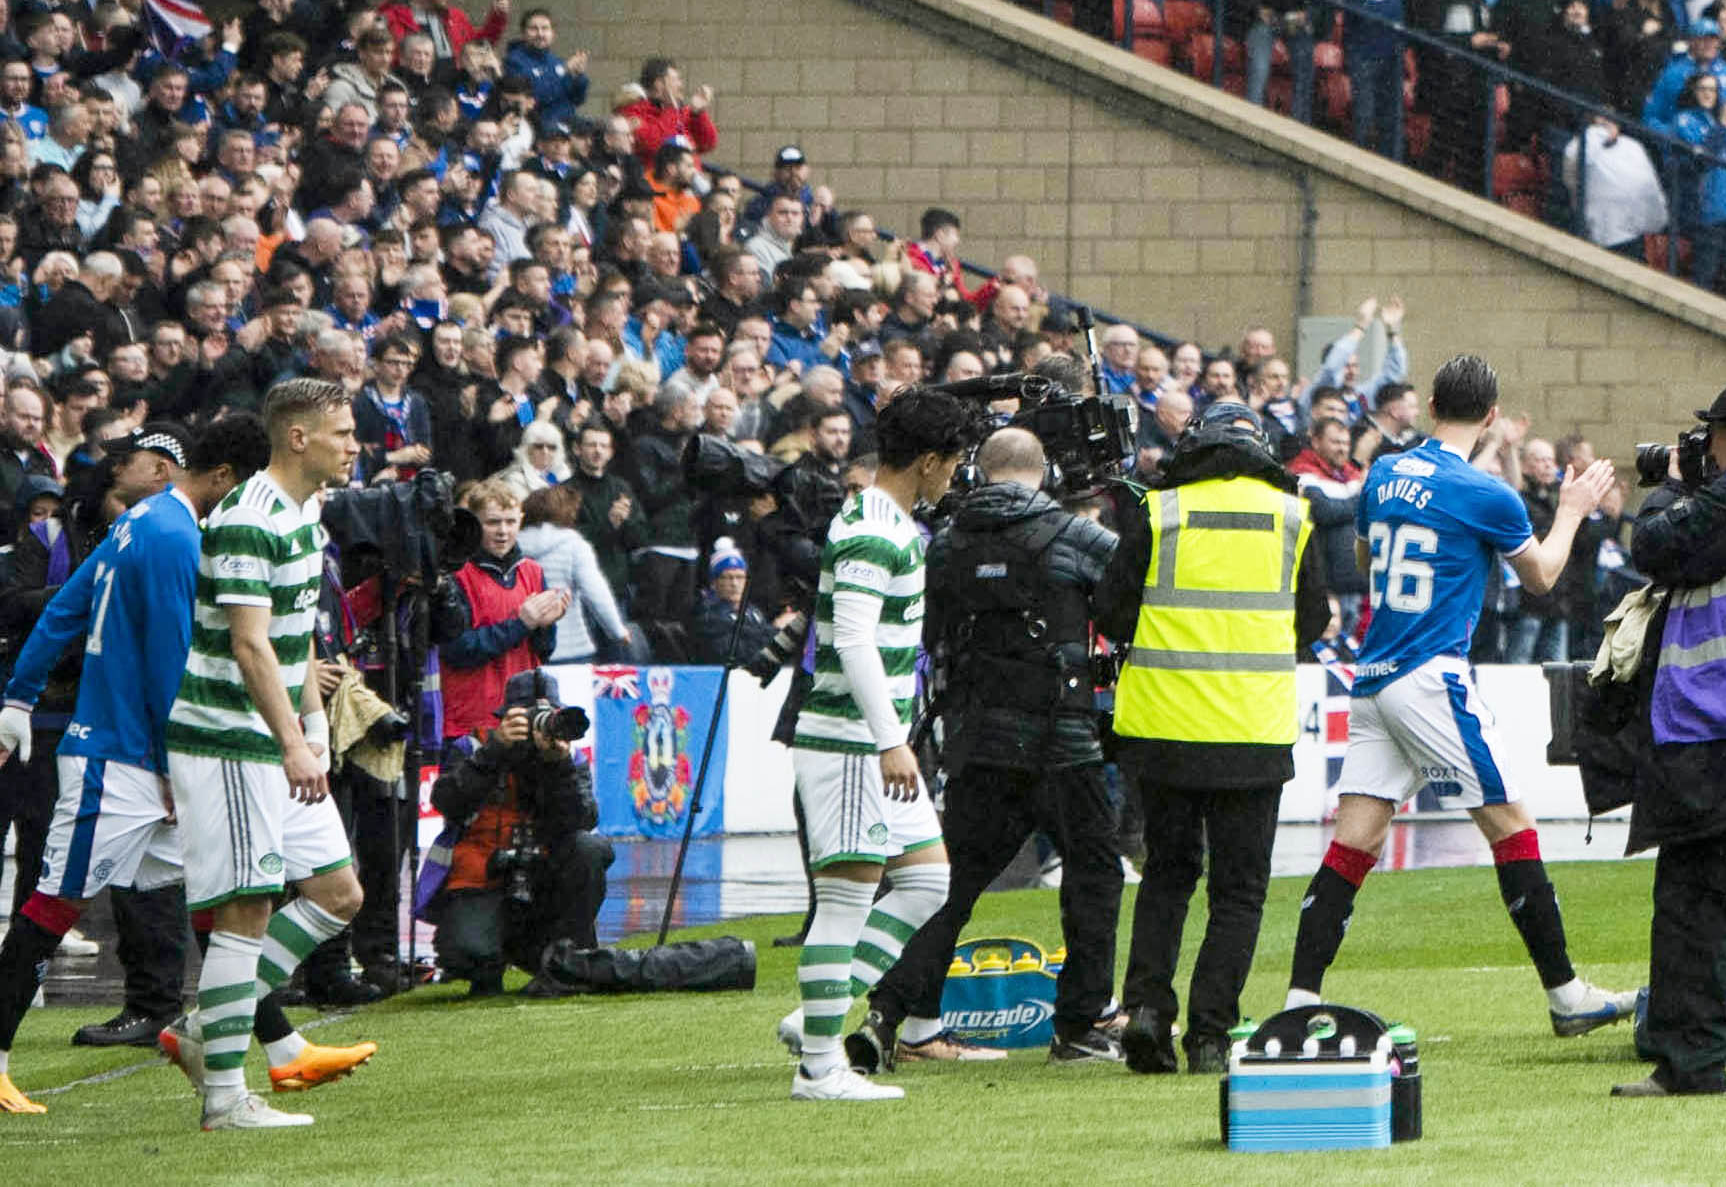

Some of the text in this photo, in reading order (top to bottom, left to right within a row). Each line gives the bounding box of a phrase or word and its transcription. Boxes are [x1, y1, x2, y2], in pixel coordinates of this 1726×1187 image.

[1377, 477, 1433, 510] DAVIES
[1368, 521, 1438, 613] 26
[943, 1003, 1037, 1028] ucozade
